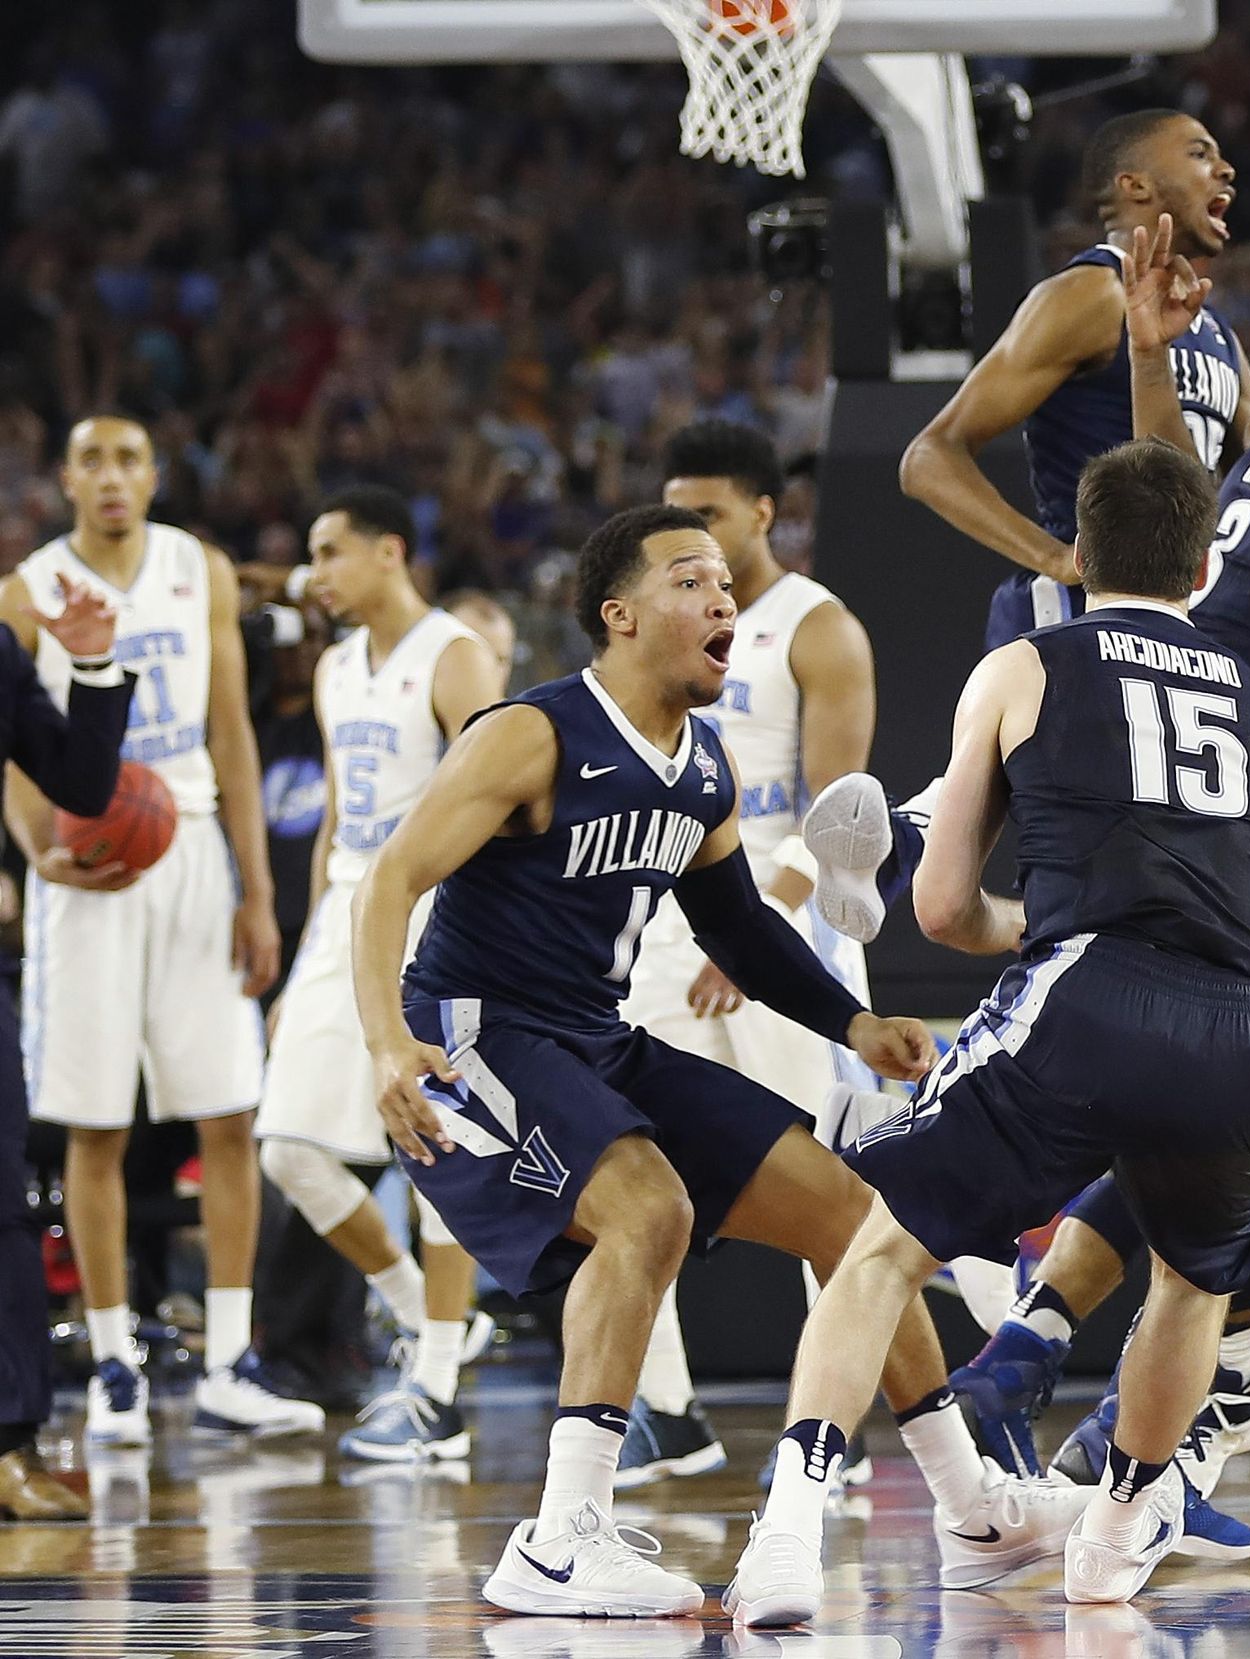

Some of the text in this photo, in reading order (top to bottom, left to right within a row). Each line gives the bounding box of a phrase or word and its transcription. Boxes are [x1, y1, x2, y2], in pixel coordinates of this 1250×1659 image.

[1097, 630, 1242, 688] ARCIDIACONO
[345, 757, 377, 815] 5
[1119, 677, 1248, 818] 15
[601, 886, 651, 983] 1
